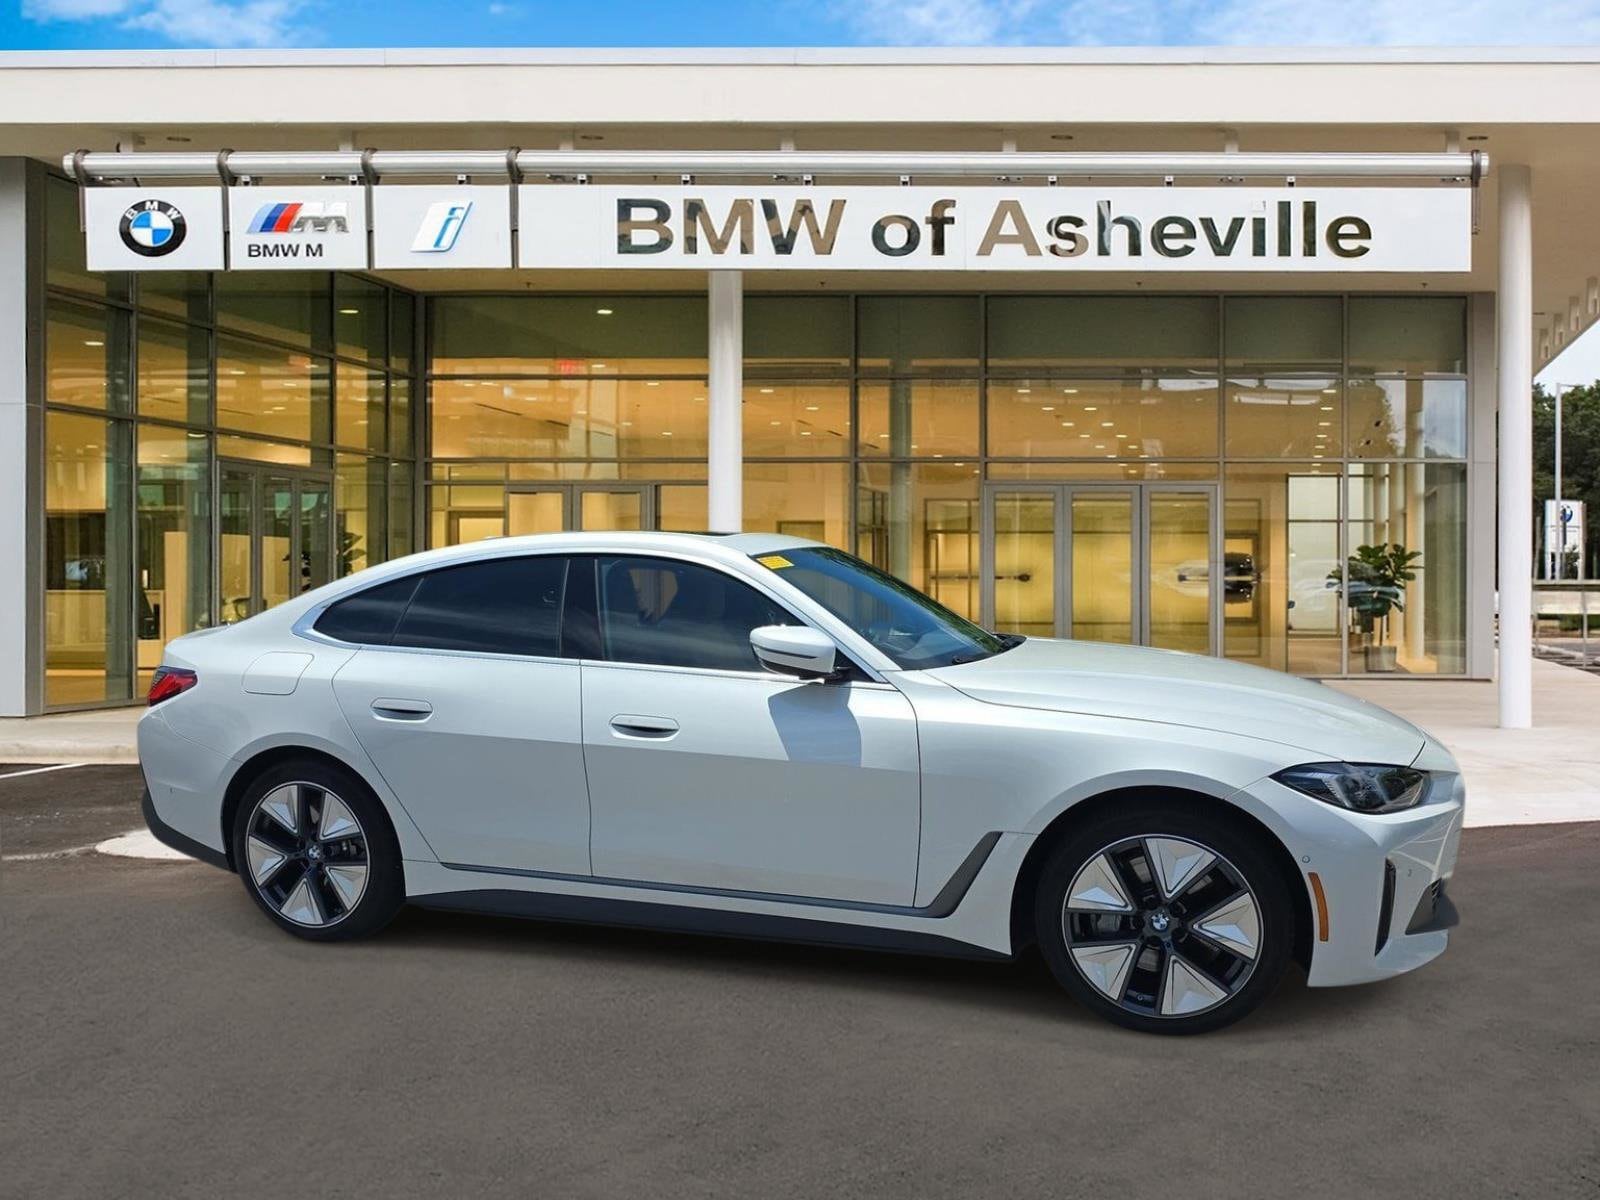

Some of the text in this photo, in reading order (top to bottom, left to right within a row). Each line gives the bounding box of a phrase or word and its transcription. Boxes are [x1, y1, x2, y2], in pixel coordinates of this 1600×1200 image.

[125, 201, 181, 220] BMW
[616, 198, 1372, 258] BMW of Asheville
[248, 243, 323, 257] BMW M
